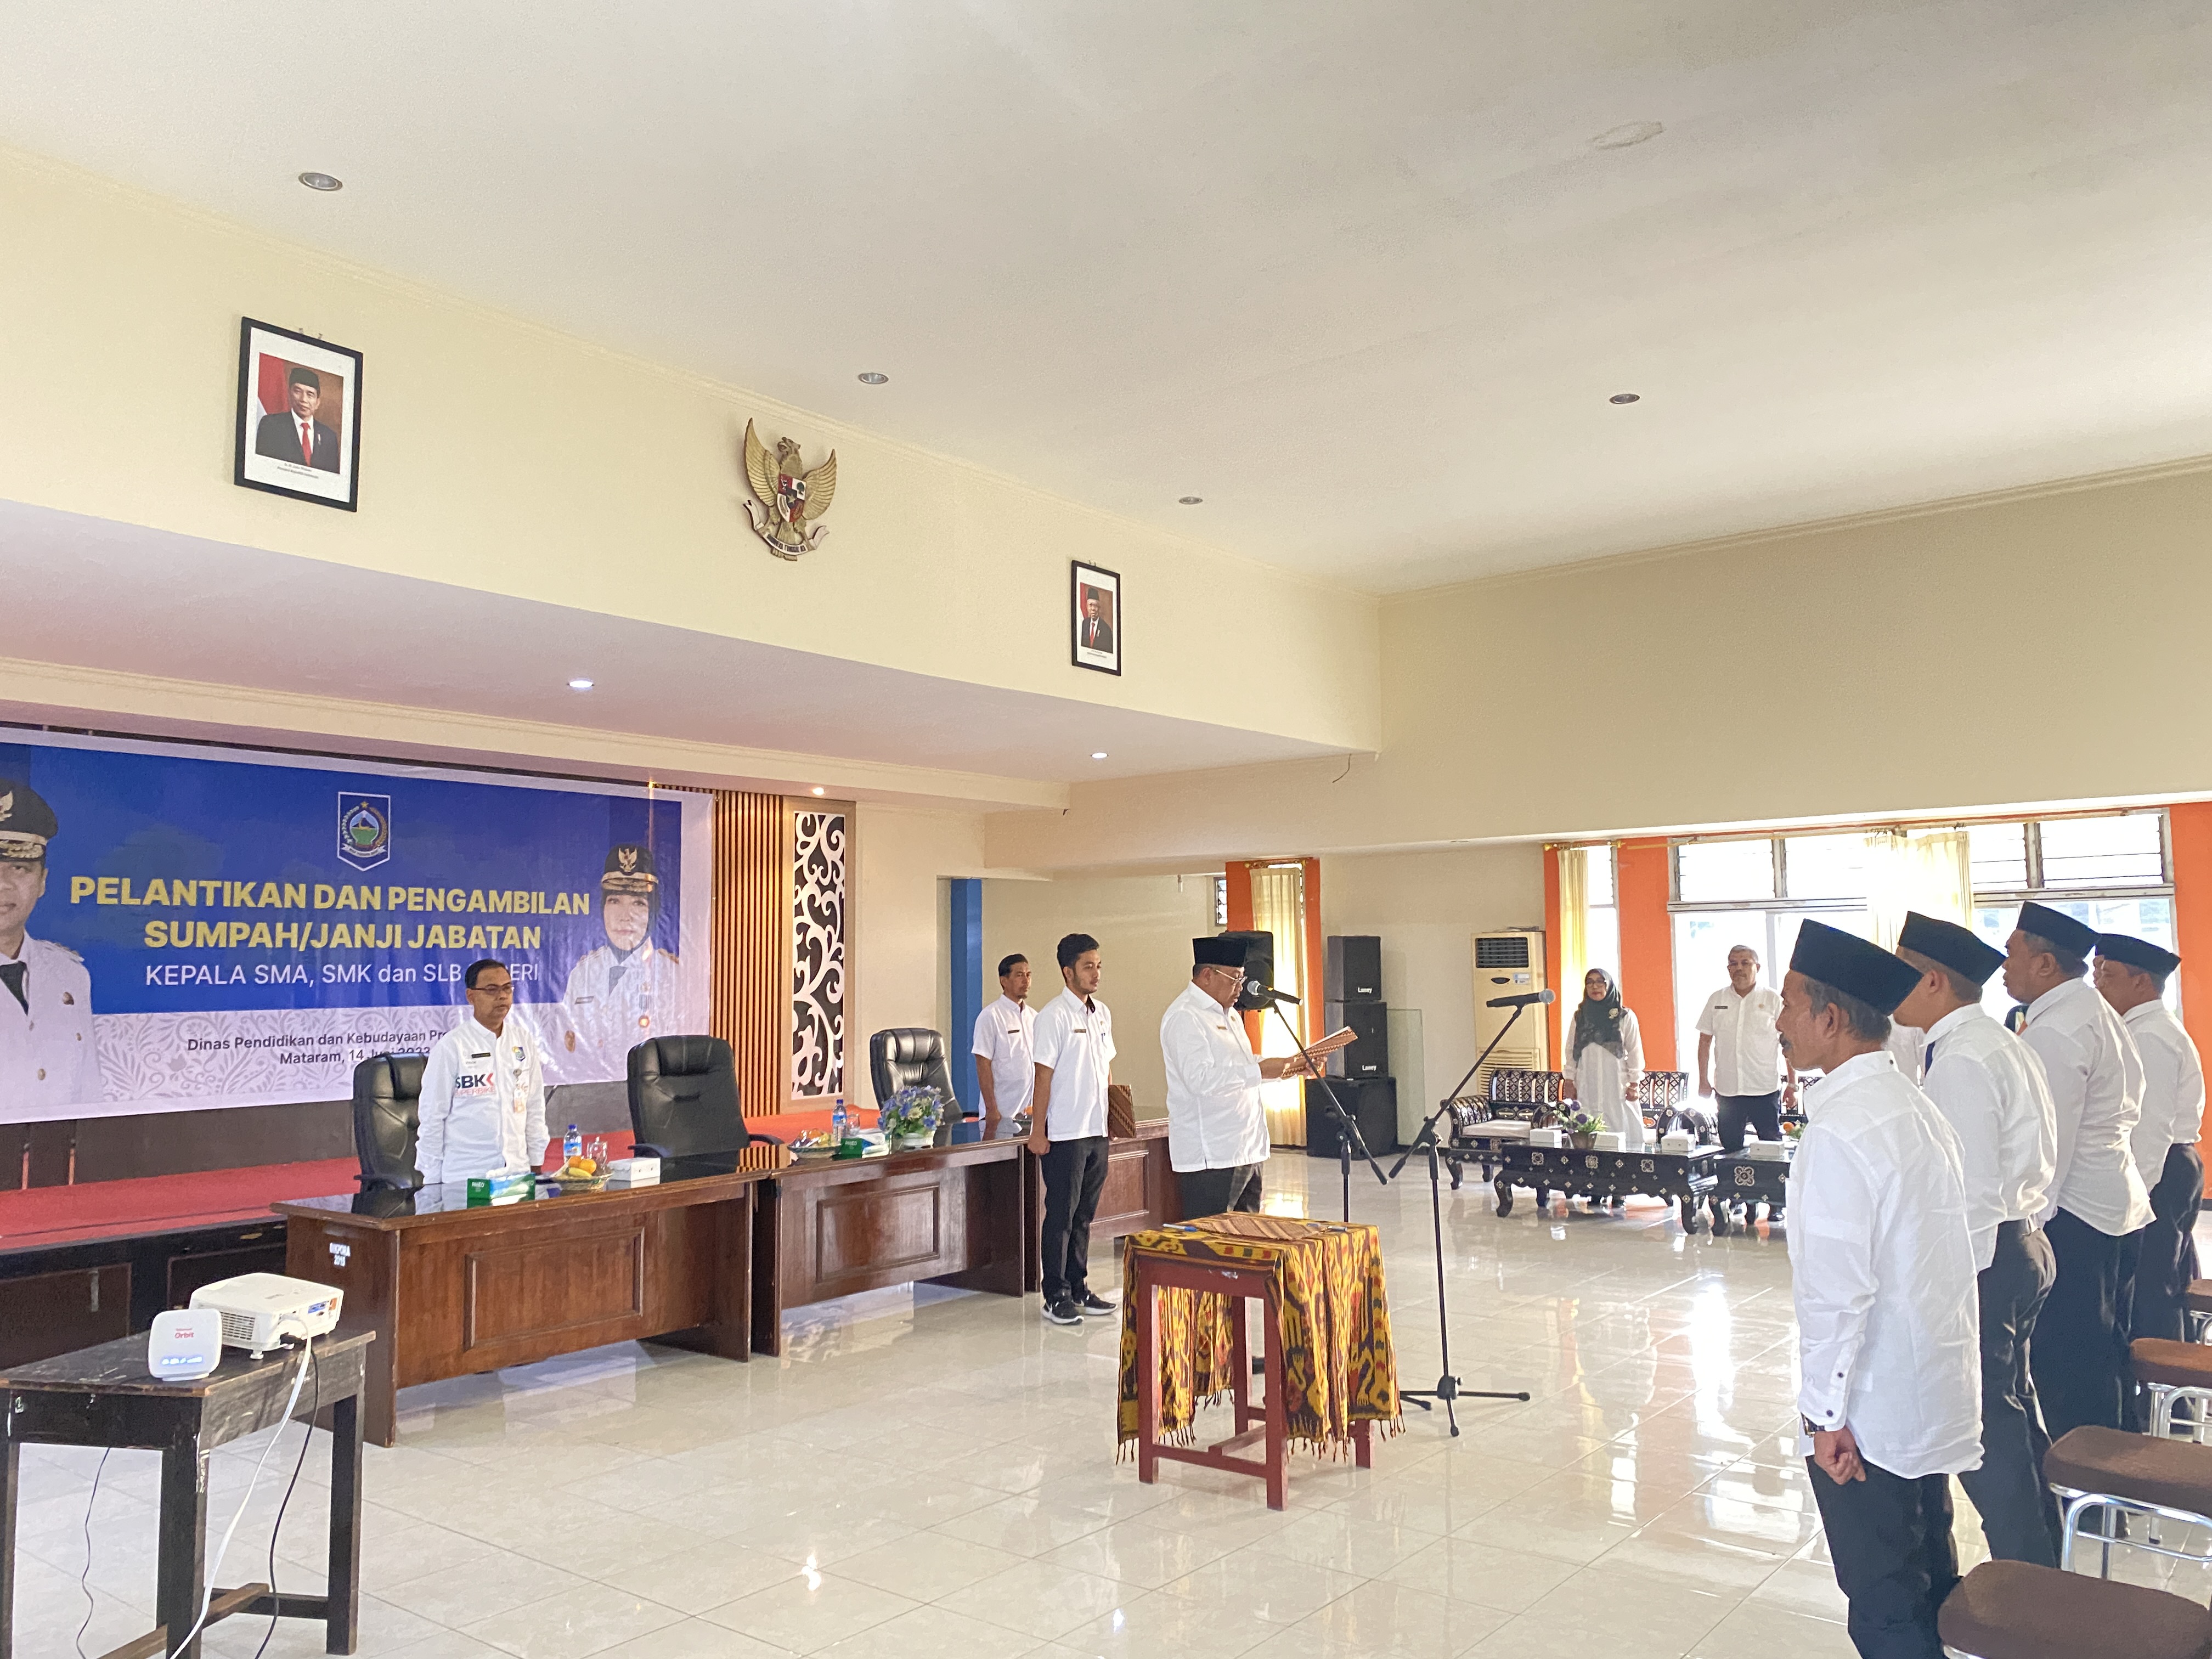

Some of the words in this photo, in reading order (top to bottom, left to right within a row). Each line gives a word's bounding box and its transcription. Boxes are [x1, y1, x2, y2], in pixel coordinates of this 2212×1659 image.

[71, 876, 306, 909] PELANTIKAN
[314, 884, 381, 910] DAN
[388, 887, 589, 915] PENGAMBILAN
[144, 921, 400, 951] SUMPAH/JANJI
[408, 924, 540, 949] JABATAN
[146, 965, 246, 986] KEPALA
[254, 964, 314, 987] SMA,
[321, 964, 371, 983] SMK
[379, 963, 416, 983] dan
[424, 963, 461, 982] SLB
[188, 1039, 230, 1051] Dinas
[235, 1036, 314, 1048] Pendidikan
[319, 1034, 342, 1045] dan
[347, 1031, 425, 1045] Kebudayaan
[430, 1030, 448, 1040] Pr
[280, 1053, 345, 1064] Mataram,
[349, 1049, 363, 1060] 14
[456, 1074, 486, 1088] SBK
